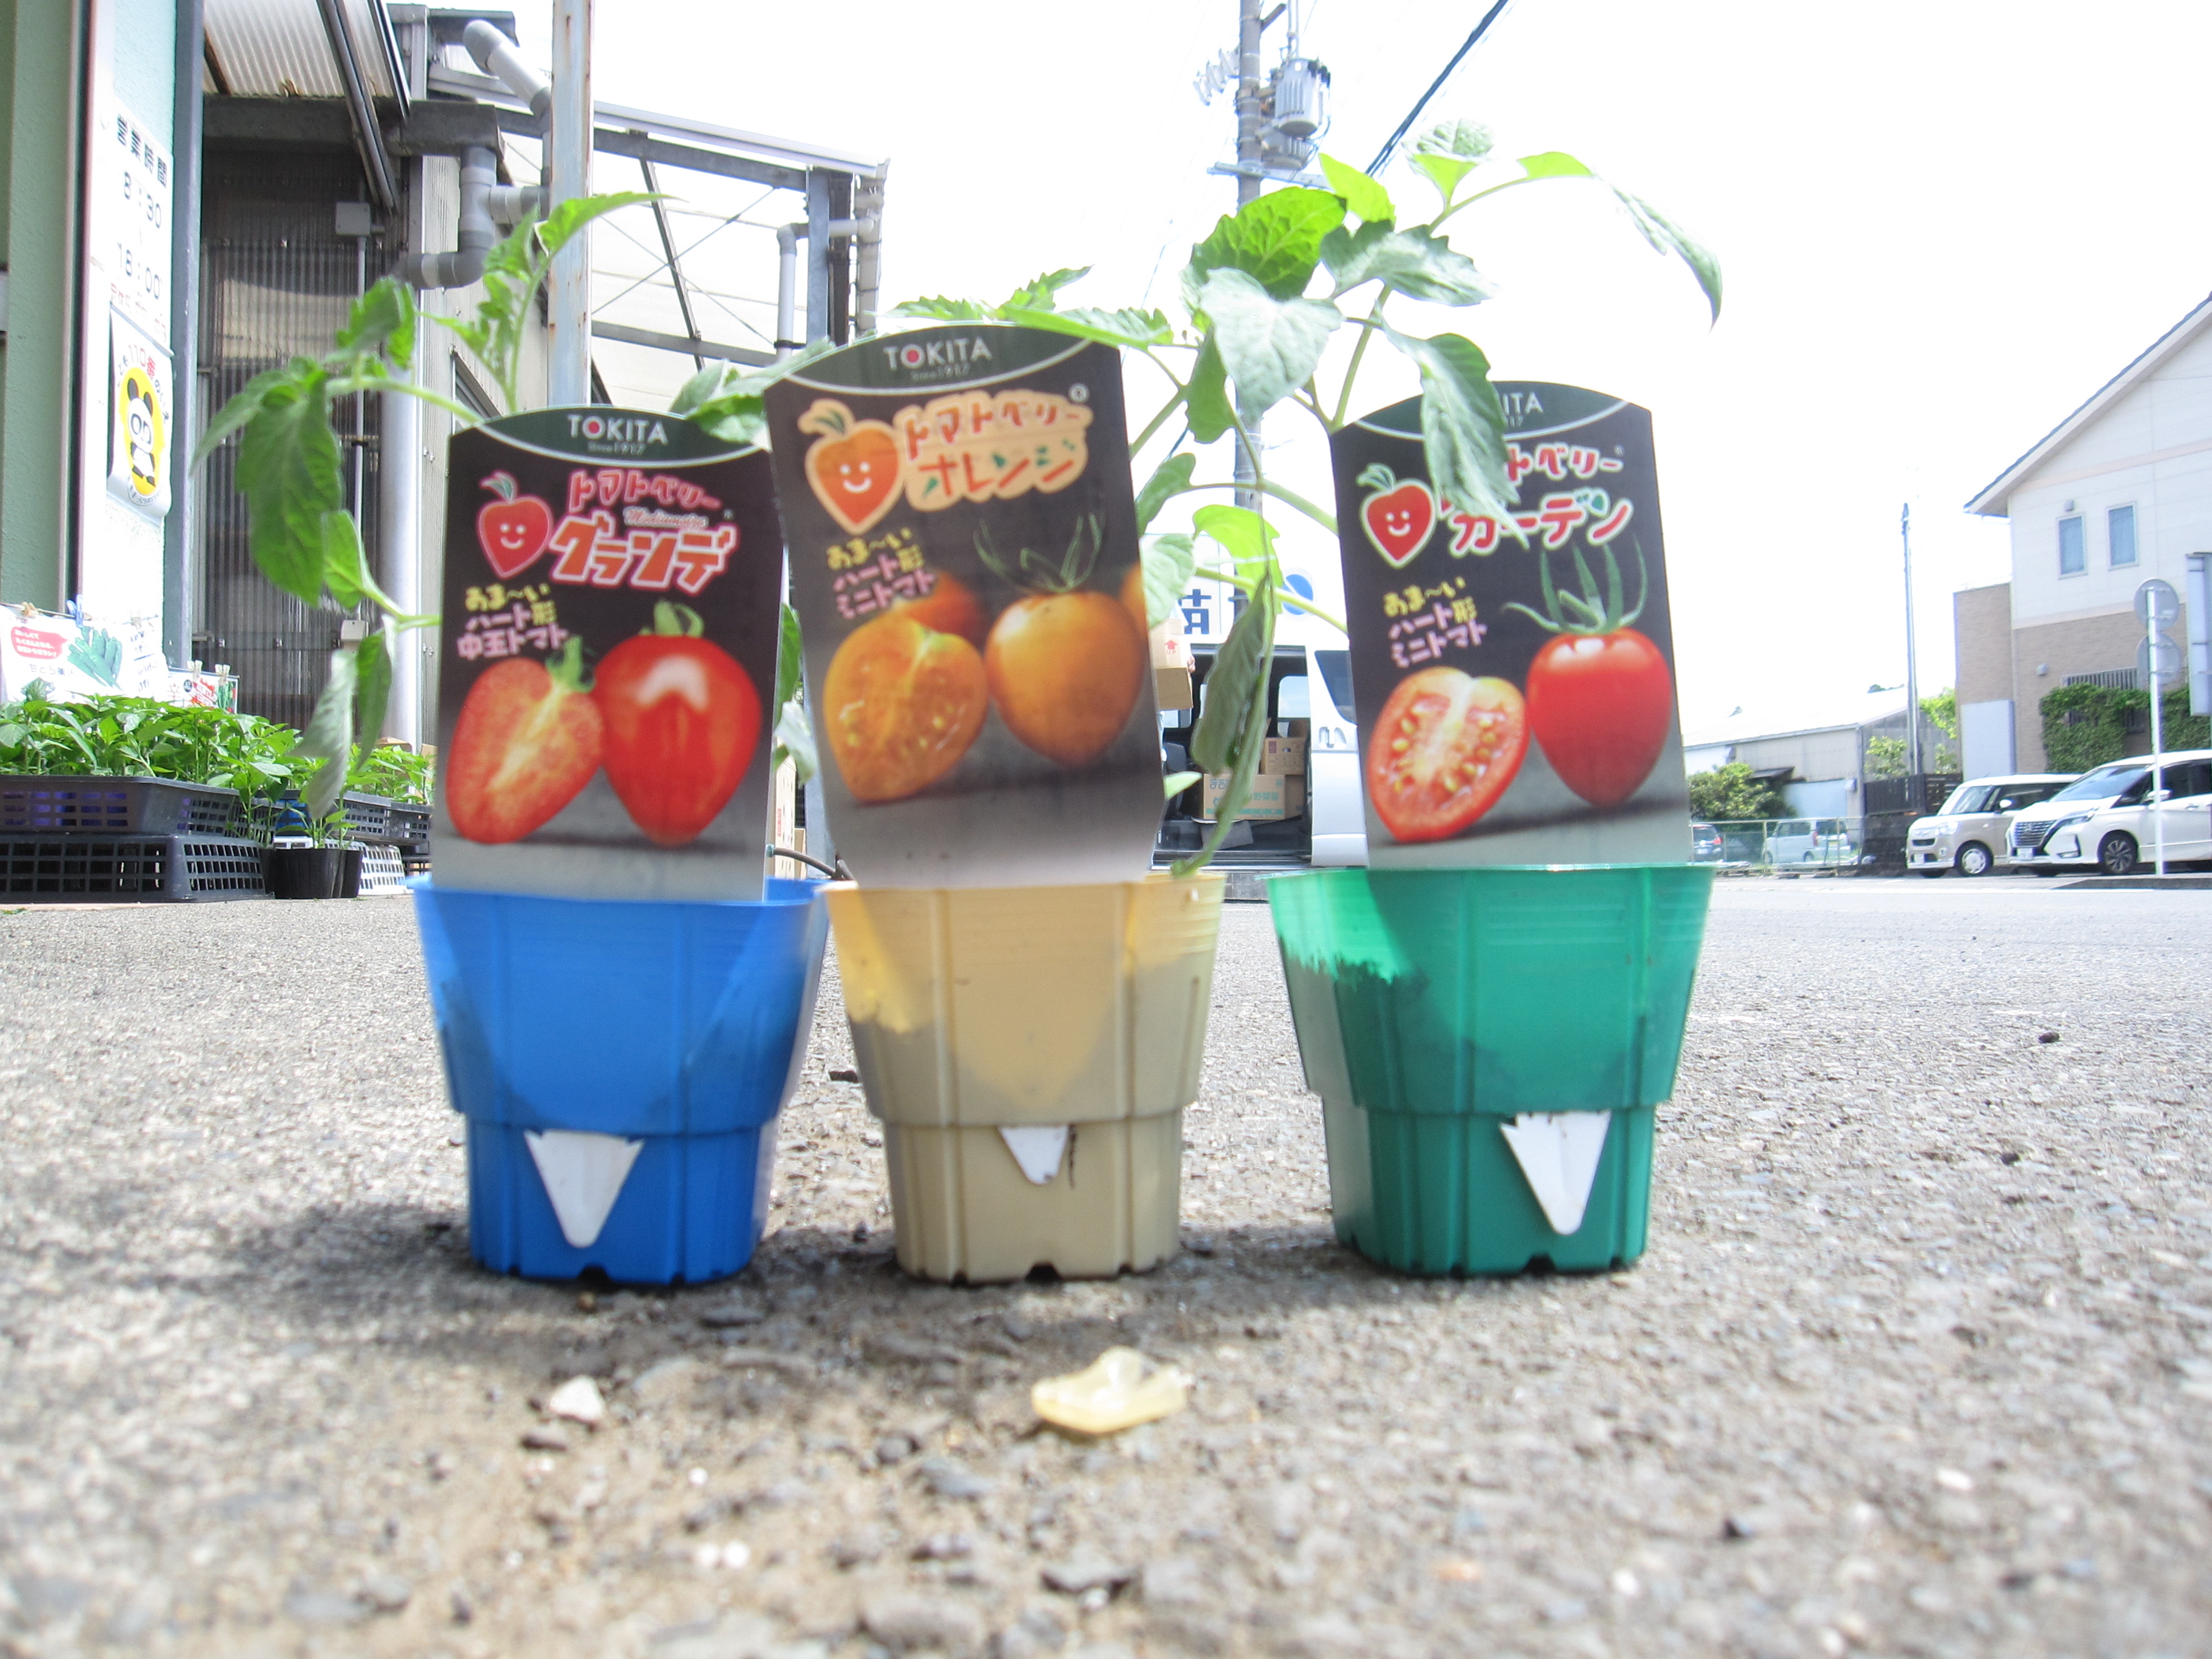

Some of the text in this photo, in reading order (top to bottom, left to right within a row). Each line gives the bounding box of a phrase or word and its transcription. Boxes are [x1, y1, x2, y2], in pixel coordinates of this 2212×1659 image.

[117, 113, 167, 189] 営業時間
[124, 170, 162, 229] 8:30
[117, 242, 160, 300] 18:00
[883, 336, 993, 371] TOKITA
[566, 414, 668, 446] TOKITA
[905, 401, 1079, 461] トマトベリー
[569, 469, 720, 512] トマトベリー
[917, 438, 1075, 498] オレンジ
[550, 511, 735, 592] グランデ
[834, 544, 925, 592] ハート形
[465, 600, 557, 631] ハート形
[837, 568, 936, 619] ミニトマト
[1387, 595, 1478, 640] ハート形
[1391, 618, 1487, 668] ミニトマト
